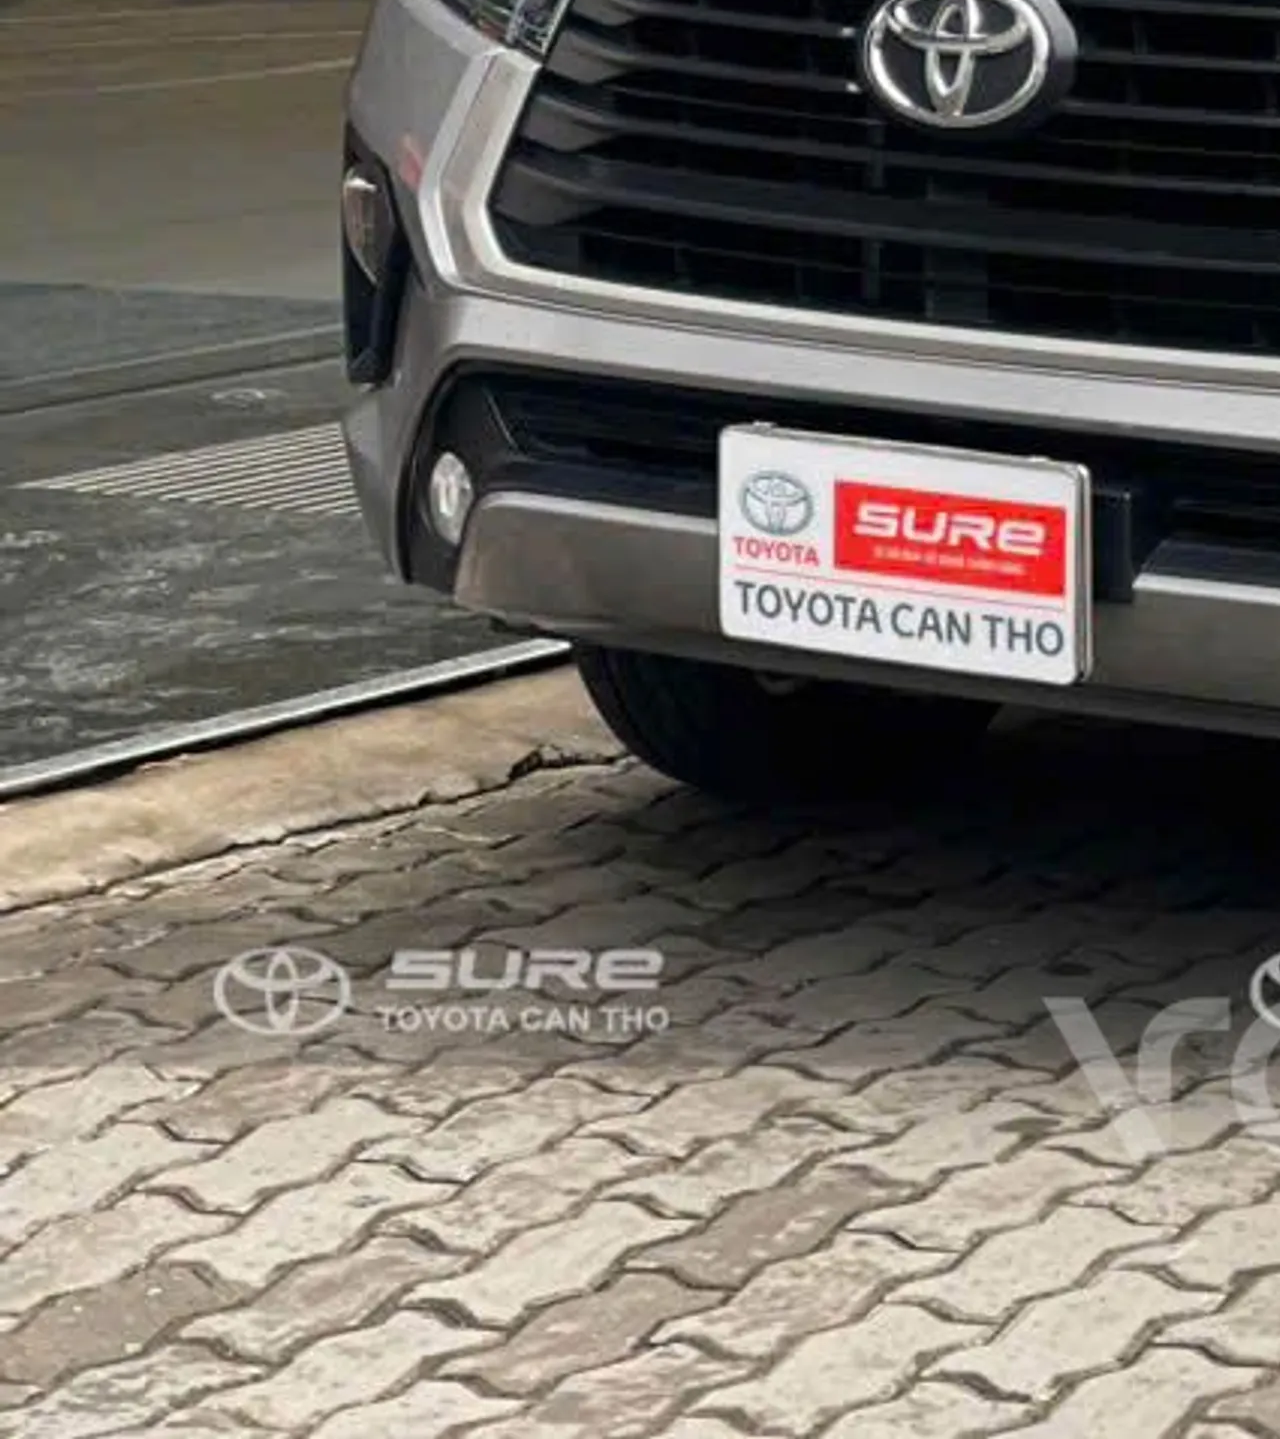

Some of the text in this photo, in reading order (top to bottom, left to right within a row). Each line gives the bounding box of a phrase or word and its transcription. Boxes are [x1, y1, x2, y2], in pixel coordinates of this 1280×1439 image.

[732, 535, 820, 567] TOYOTA
[853, 503, 1050, 556] SURE
[735, 580, 1065, 658] TOYOTA CAN THO
